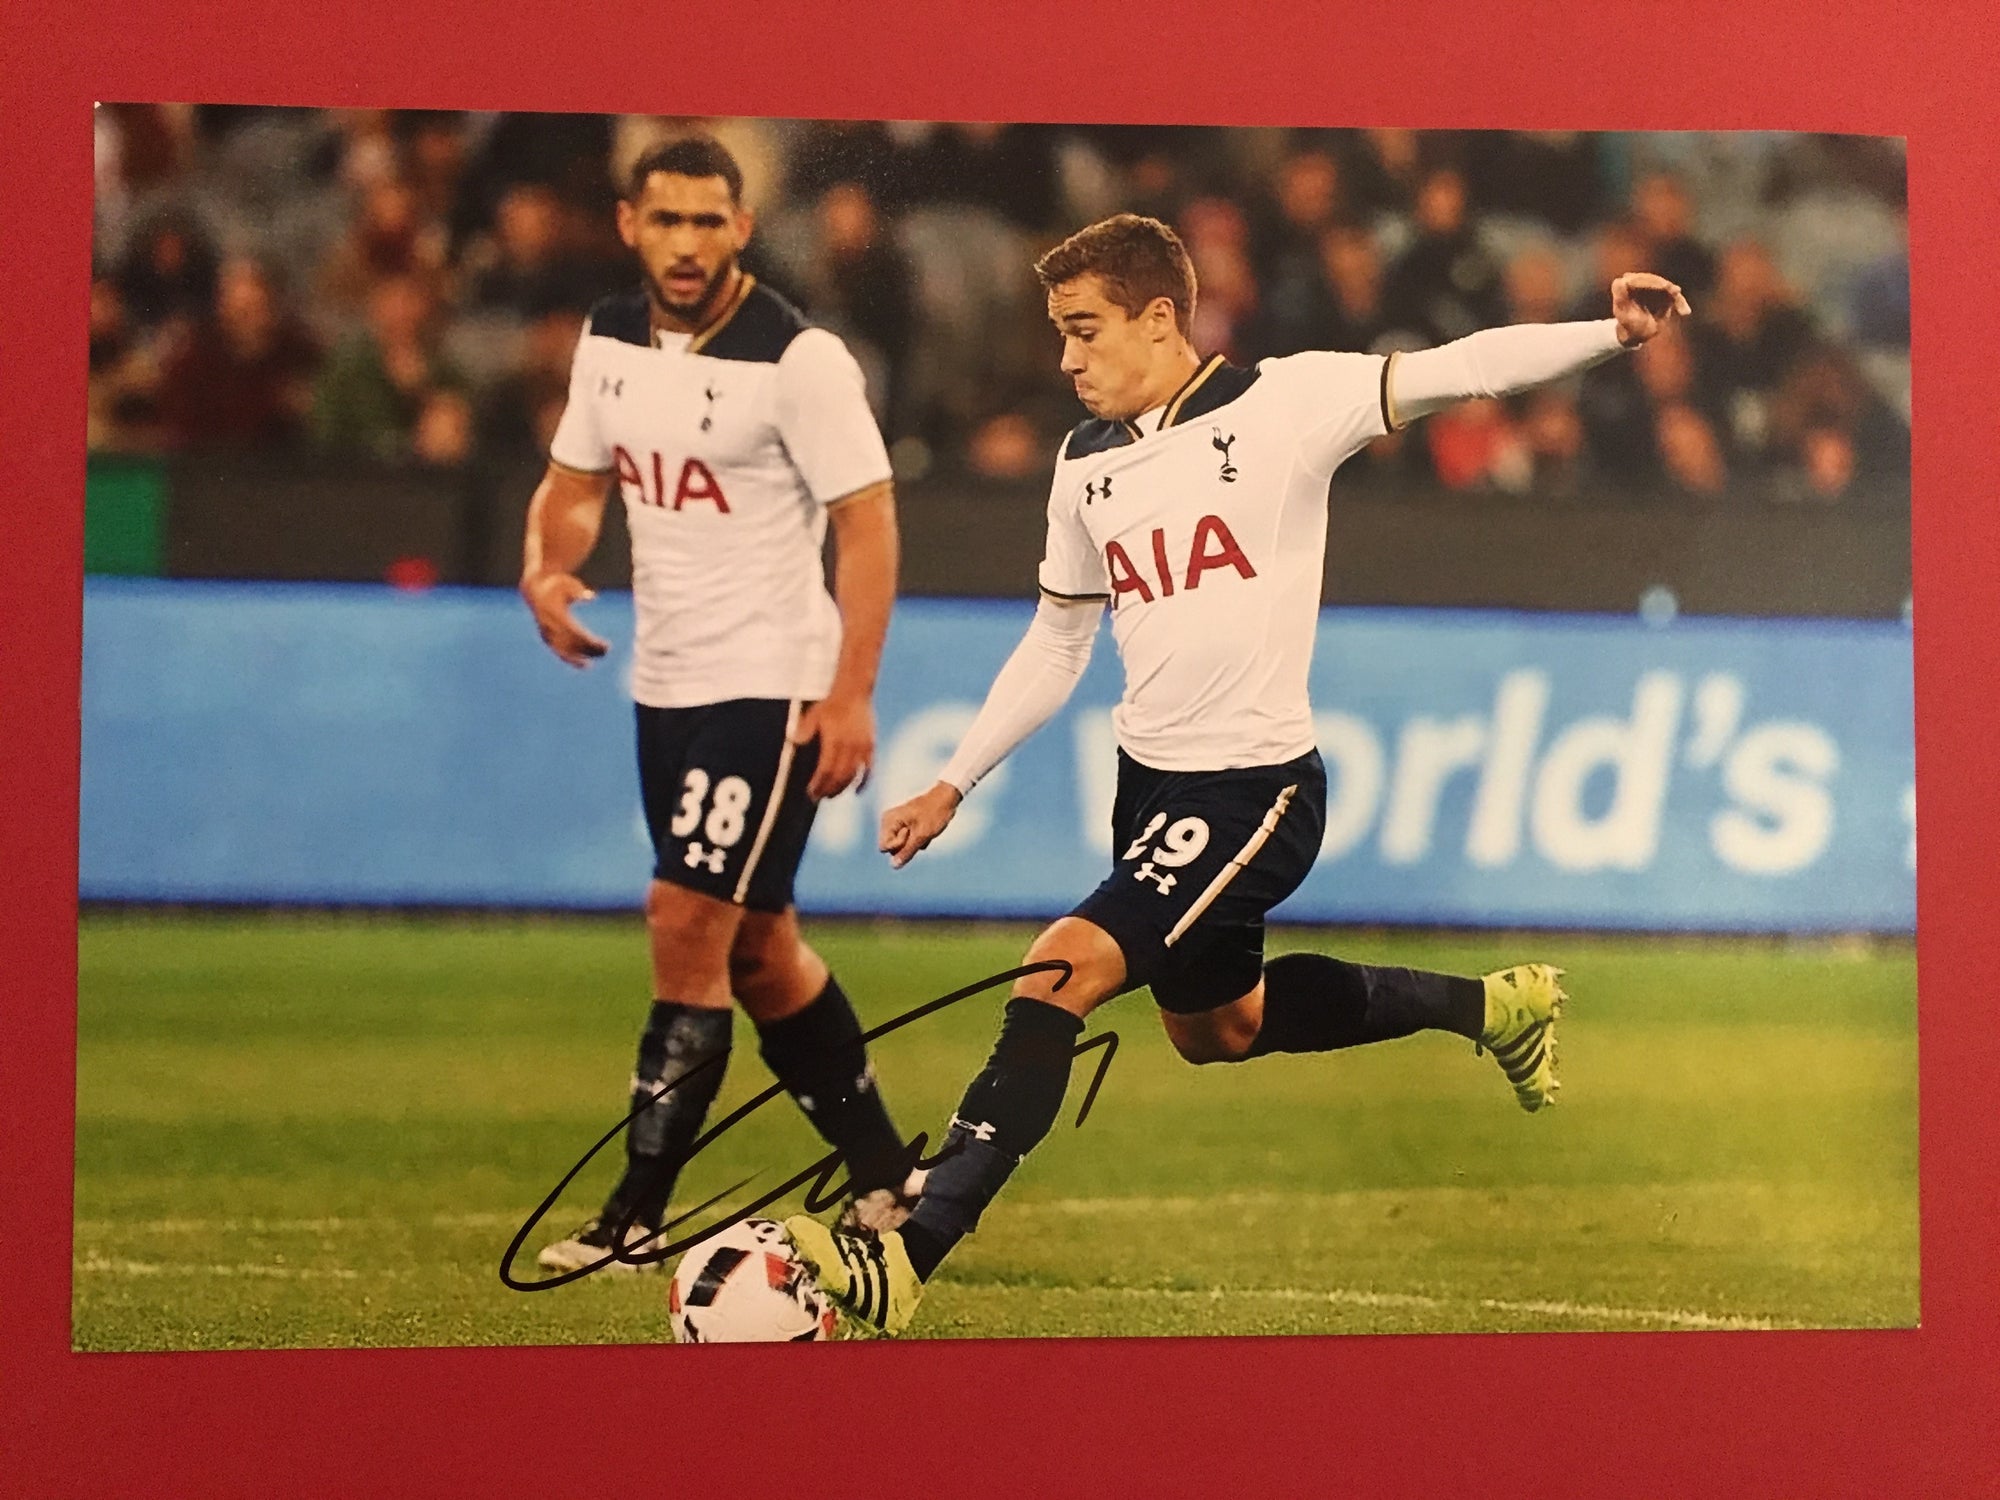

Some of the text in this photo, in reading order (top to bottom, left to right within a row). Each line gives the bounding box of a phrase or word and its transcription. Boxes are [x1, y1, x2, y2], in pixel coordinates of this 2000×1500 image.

[611, 445, 732, 514] AIA
[1105, 514, 1258, 611] AIA
[671, 767, 752, 848] 38
[1072, 668, 1840, 876] rld's
